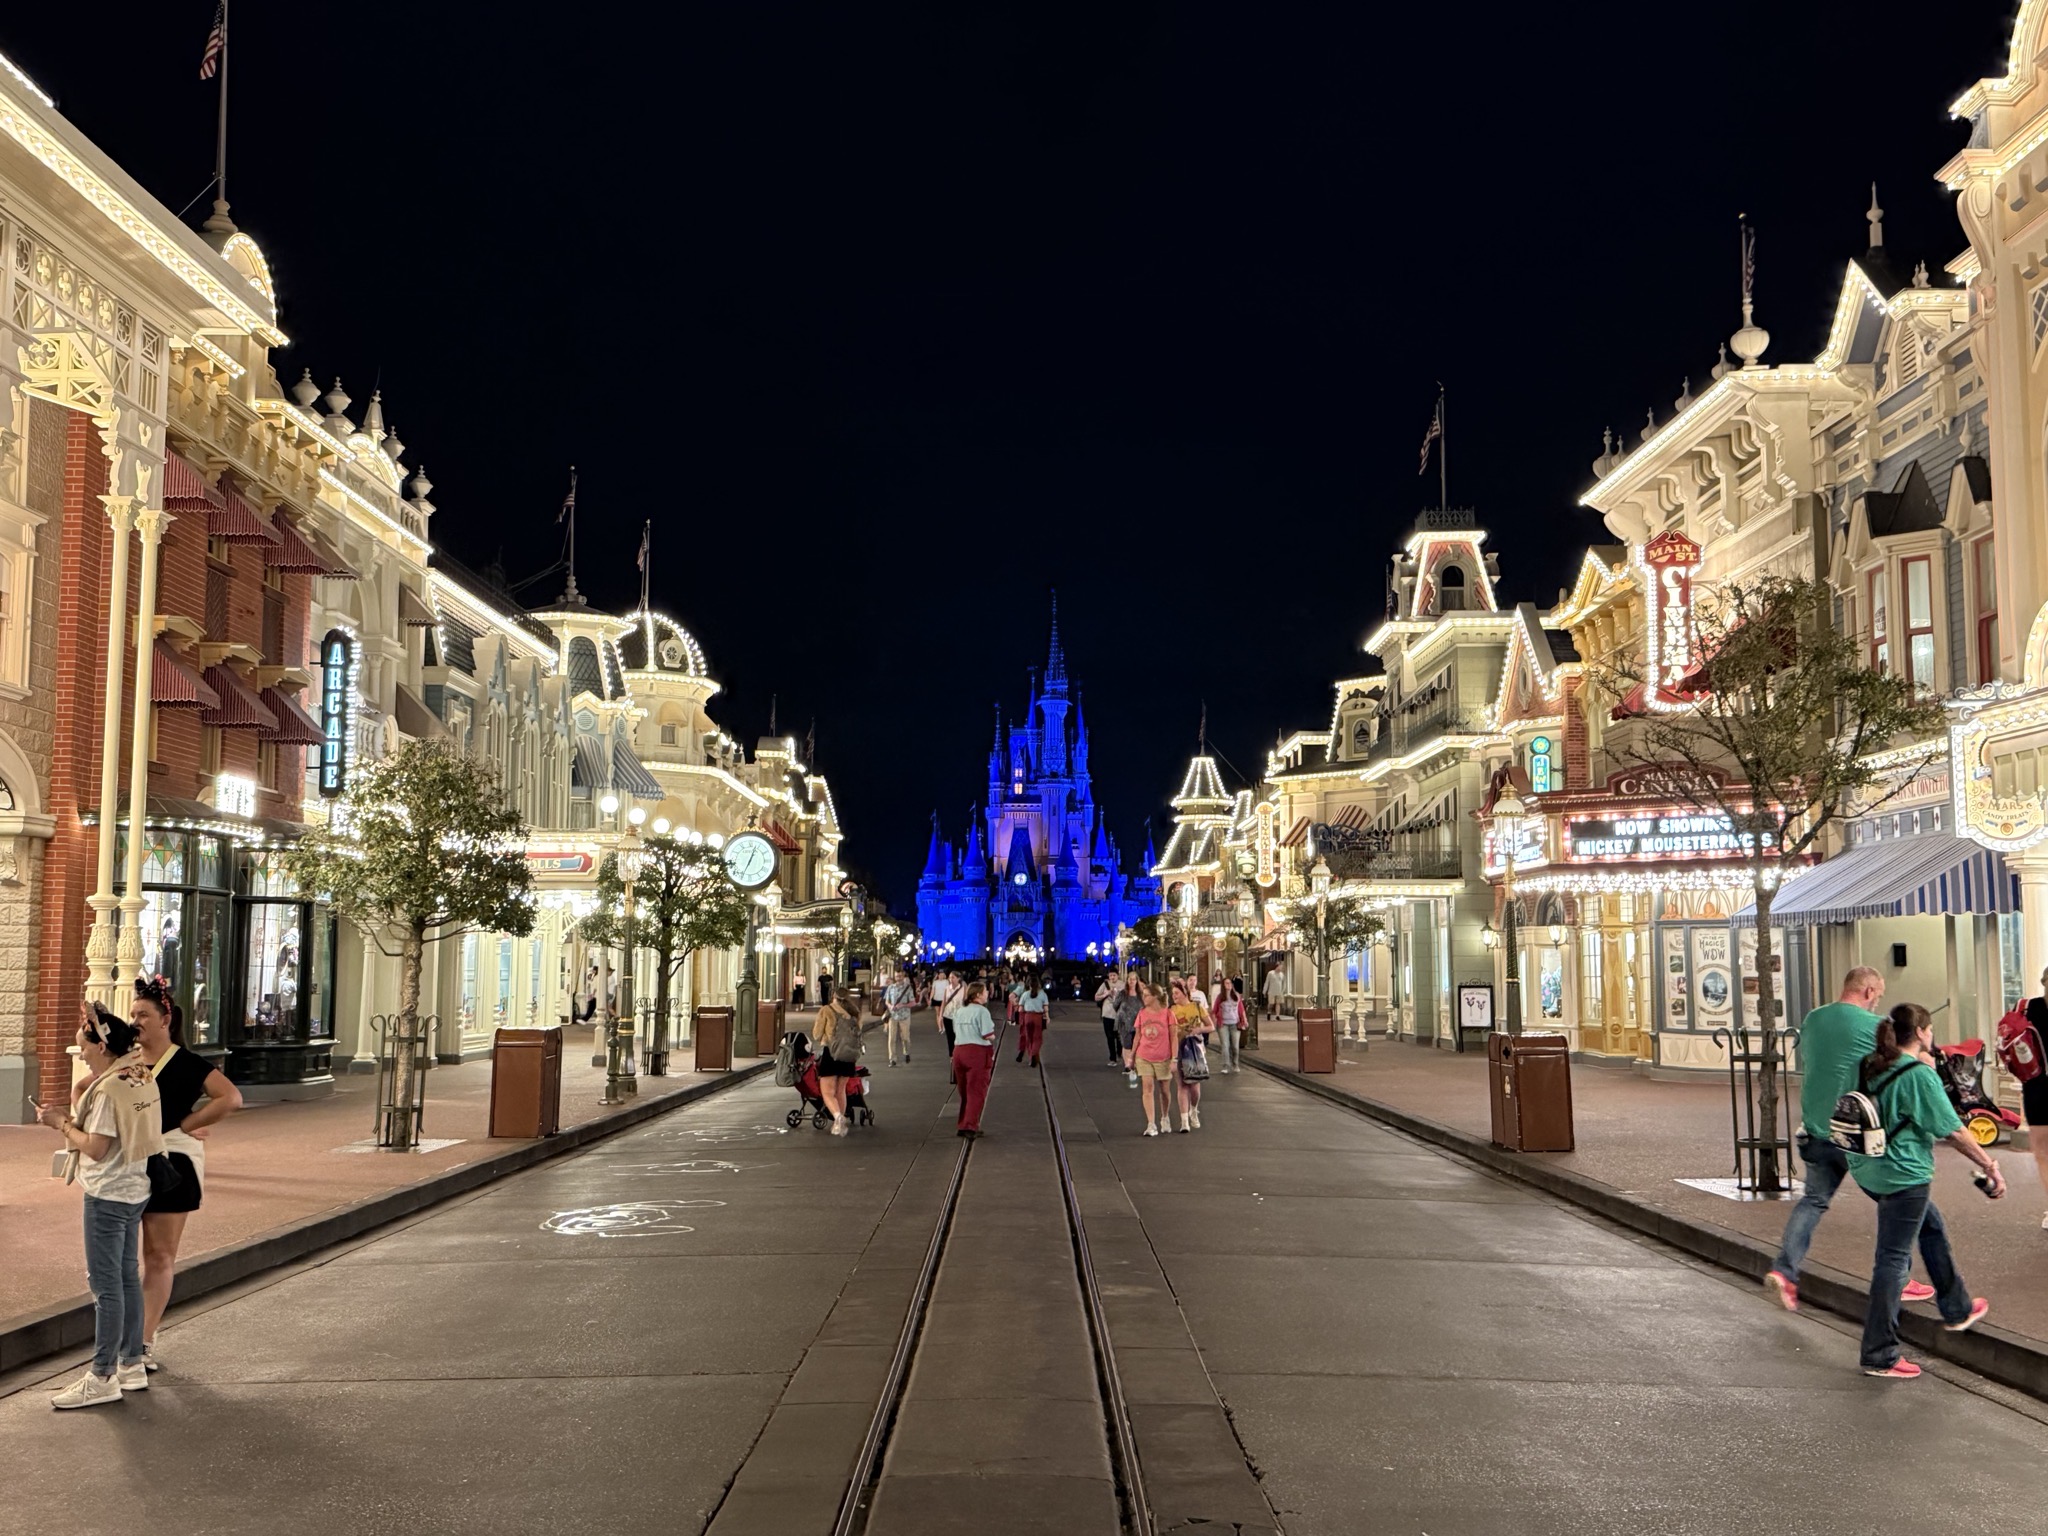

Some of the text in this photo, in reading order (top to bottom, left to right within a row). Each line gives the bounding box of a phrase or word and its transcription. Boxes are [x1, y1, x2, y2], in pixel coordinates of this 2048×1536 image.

[1649, 543, 1693, 561] MAIN
[1675, 552, 1698, 562] ST.
[1661, 566, 1690, 686] CINEMA
[324, 643, 343, 787] ARCADE
[1988, 799, 2023, 811] MARS
[1982, 810, 2030, 820] CANDY TREATS
[1614, 816, 1733, 836] NOW SHOWING
[1578, 832, 1774, 855] MICKEY MOUSETERPICS
